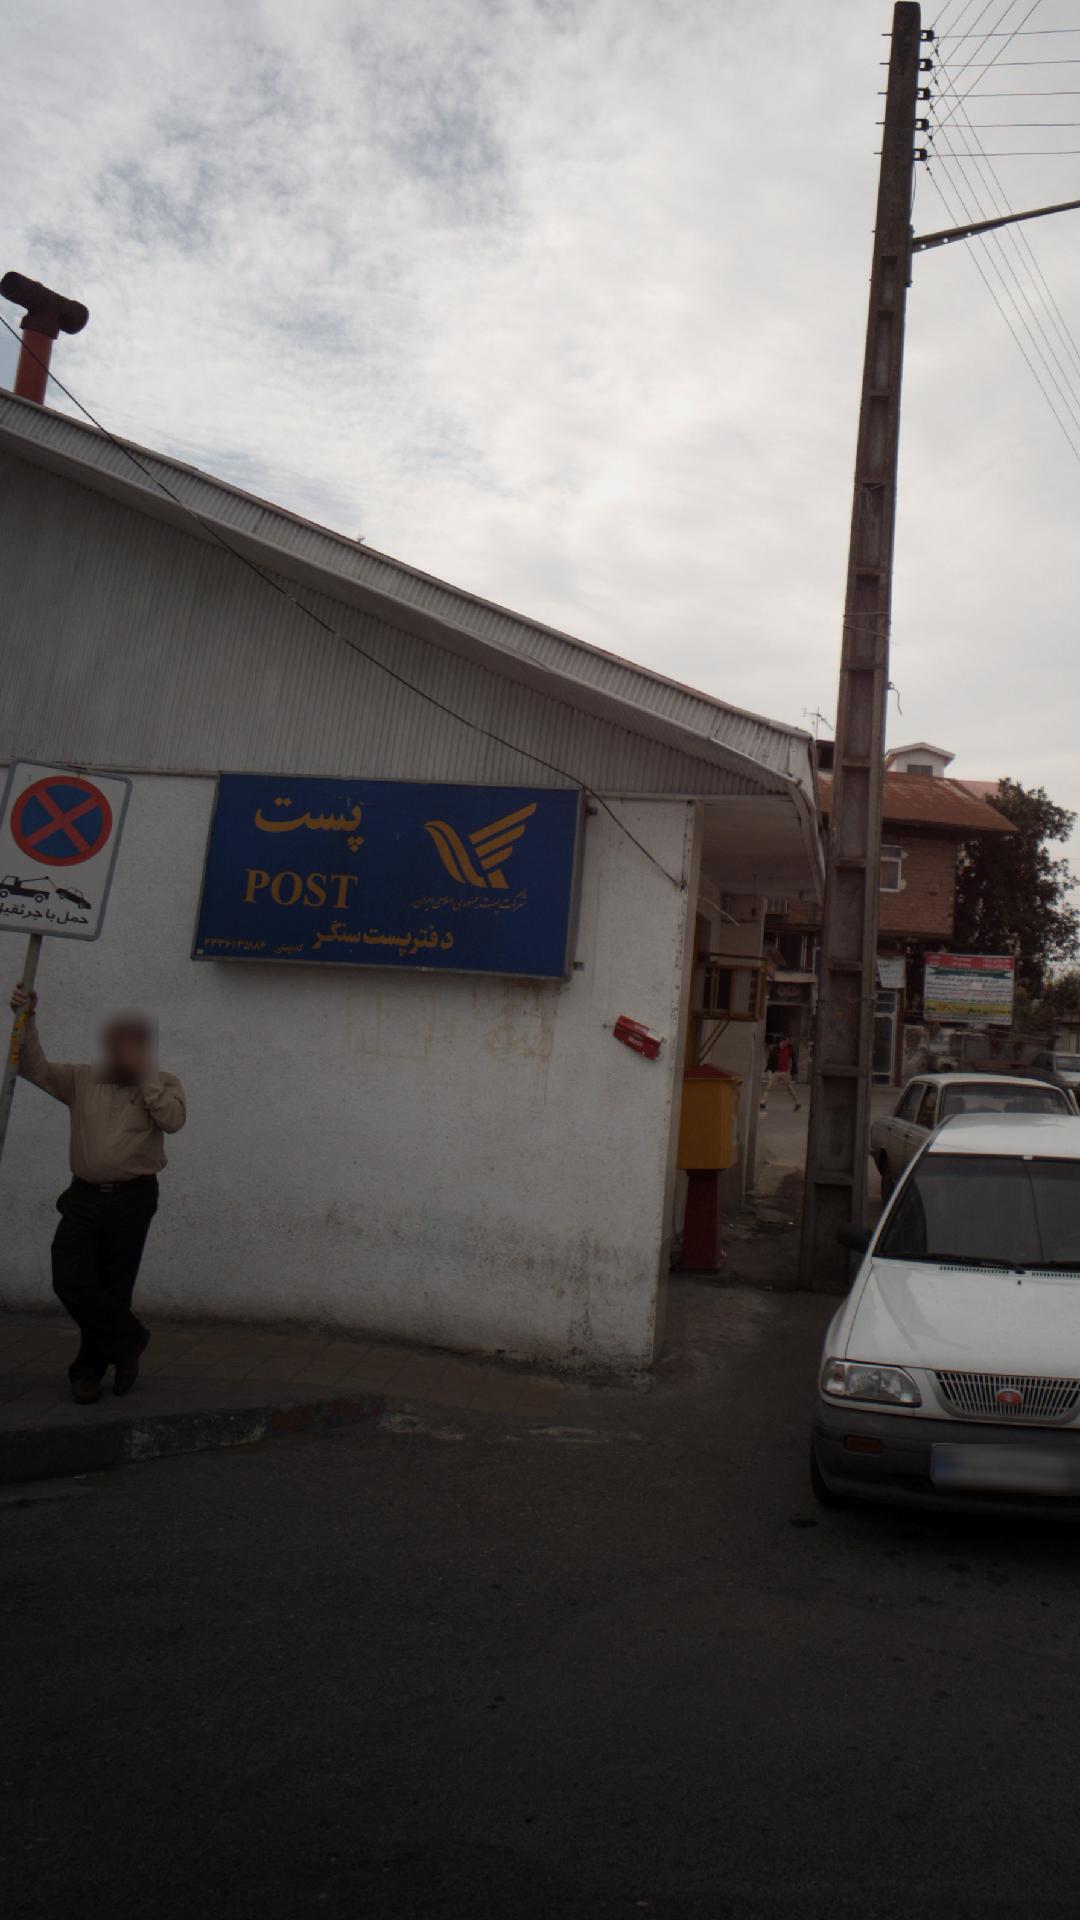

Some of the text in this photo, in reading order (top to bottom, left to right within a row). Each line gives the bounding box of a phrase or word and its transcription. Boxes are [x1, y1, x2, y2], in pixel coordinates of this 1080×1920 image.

[255, 796, 364, 853] پست
[242, 867, 359, 909] POST
[499, 888, 528, 912] شرکت
[45, 908, 56, 922] با
[57, 912, 88, 925] حمل
[312, 919, 455, 957] دفتر پست سنگر
